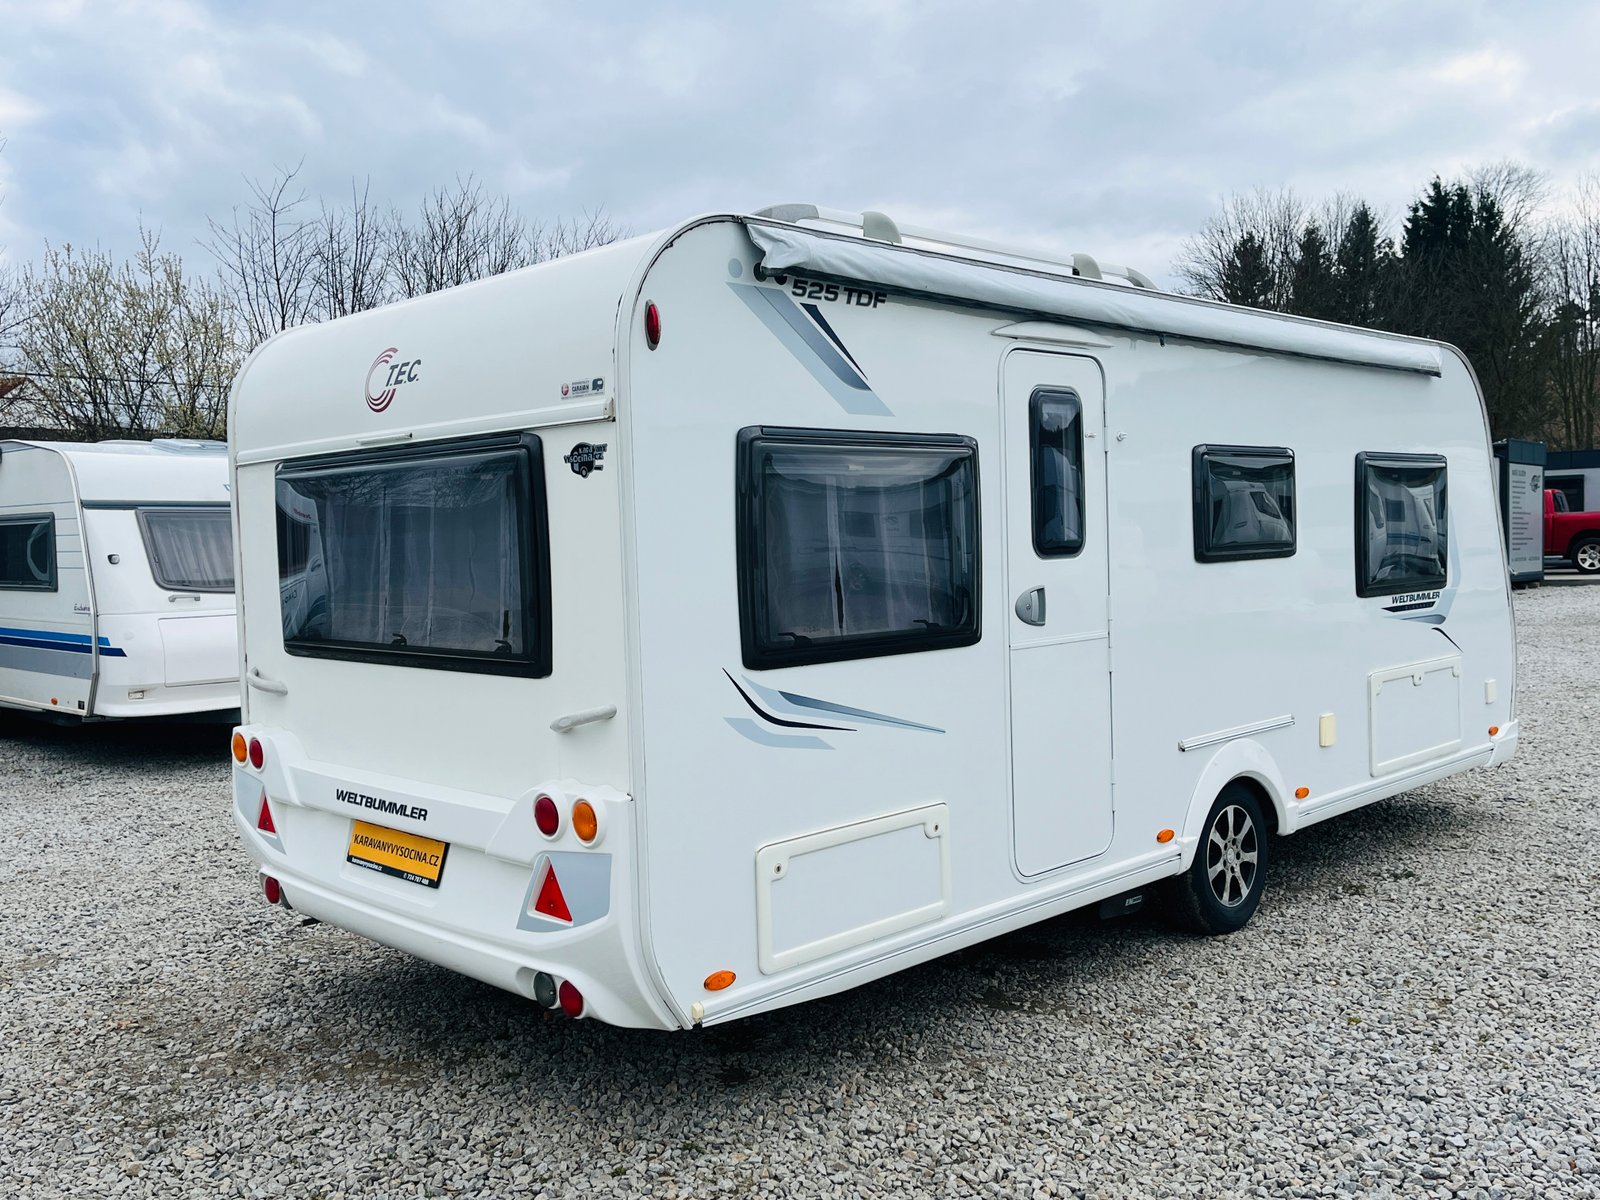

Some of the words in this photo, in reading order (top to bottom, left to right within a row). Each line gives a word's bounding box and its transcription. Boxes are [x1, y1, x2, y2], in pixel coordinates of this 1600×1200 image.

[792, 279, 840, 302] 525
[843, 287, 888, 309] TDF
[385, 359, 422, 387] T.E.C.
[1391, 591, 1441, 605] WELTBUMMLER
[336, 788, 429, 822] WELTBUMMLER
[353, 833, 440, 867] KARAVANYVYSOCINA.CZ
